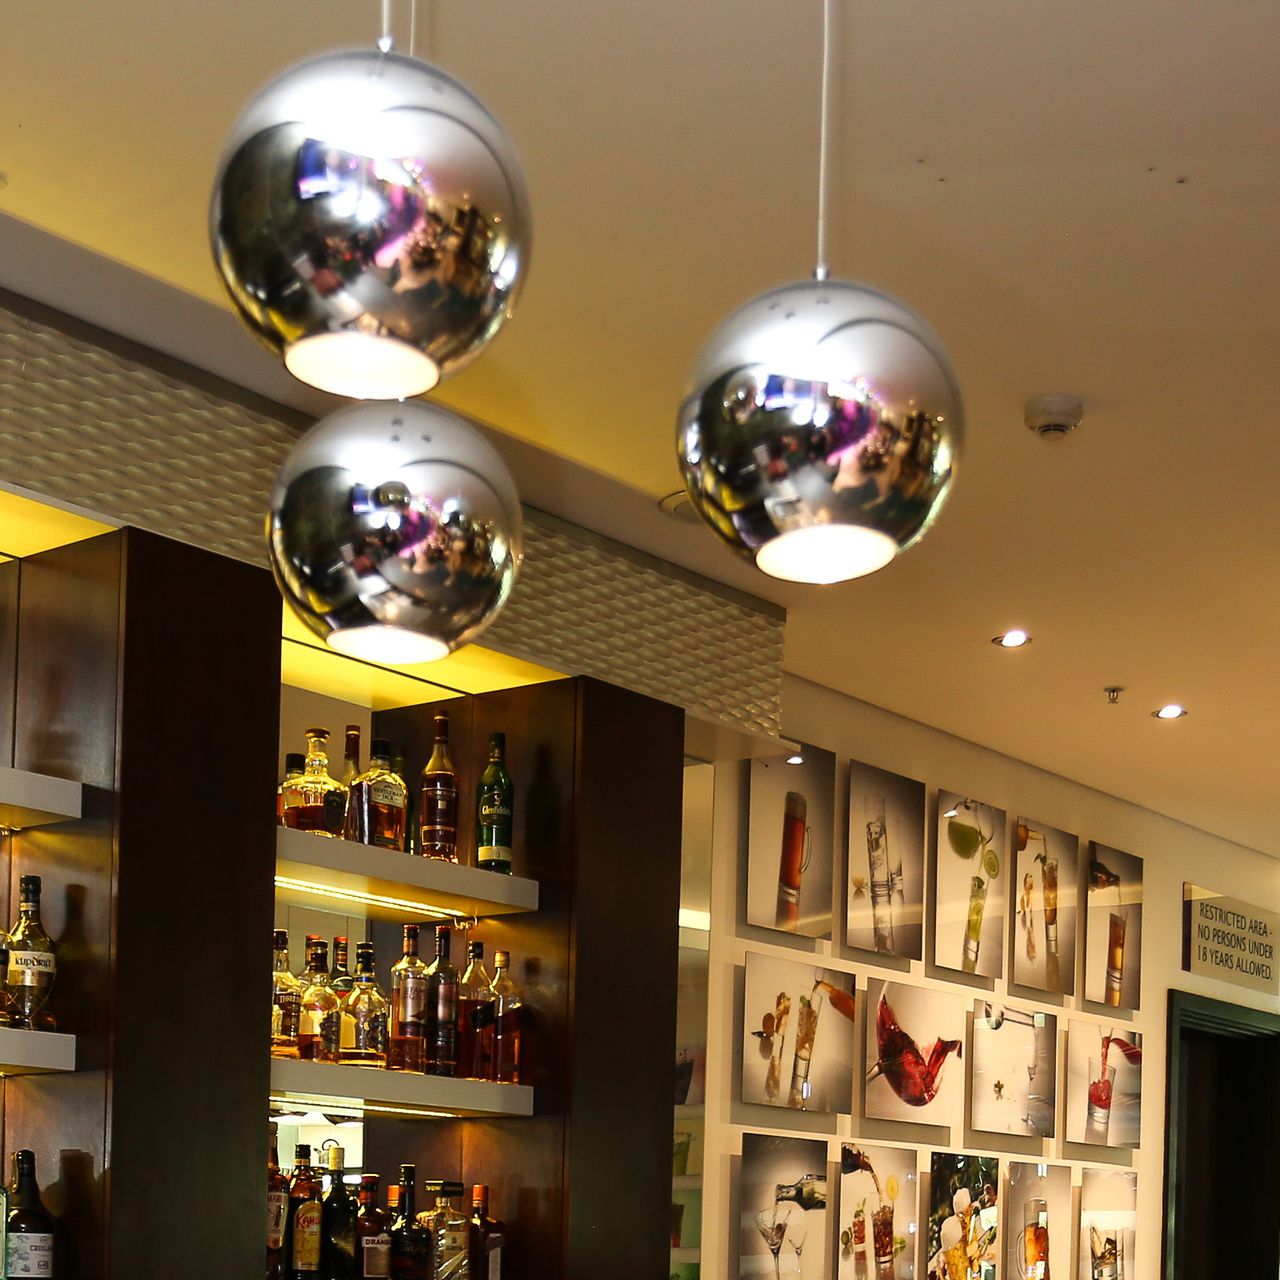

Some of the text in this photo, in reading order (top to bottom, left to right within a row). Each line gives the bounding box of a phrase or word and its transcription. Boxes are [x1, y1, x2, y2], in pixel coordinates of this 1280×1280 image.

[1199, 902, 1246, 930] RESTRICTED
[1248, 919, 1268, 938] AREA
[1198, 924, 1274, 961] NO PERSONS UNDER
[1198, 945, 1273, 981] 18 YEARS ALLOWED.
